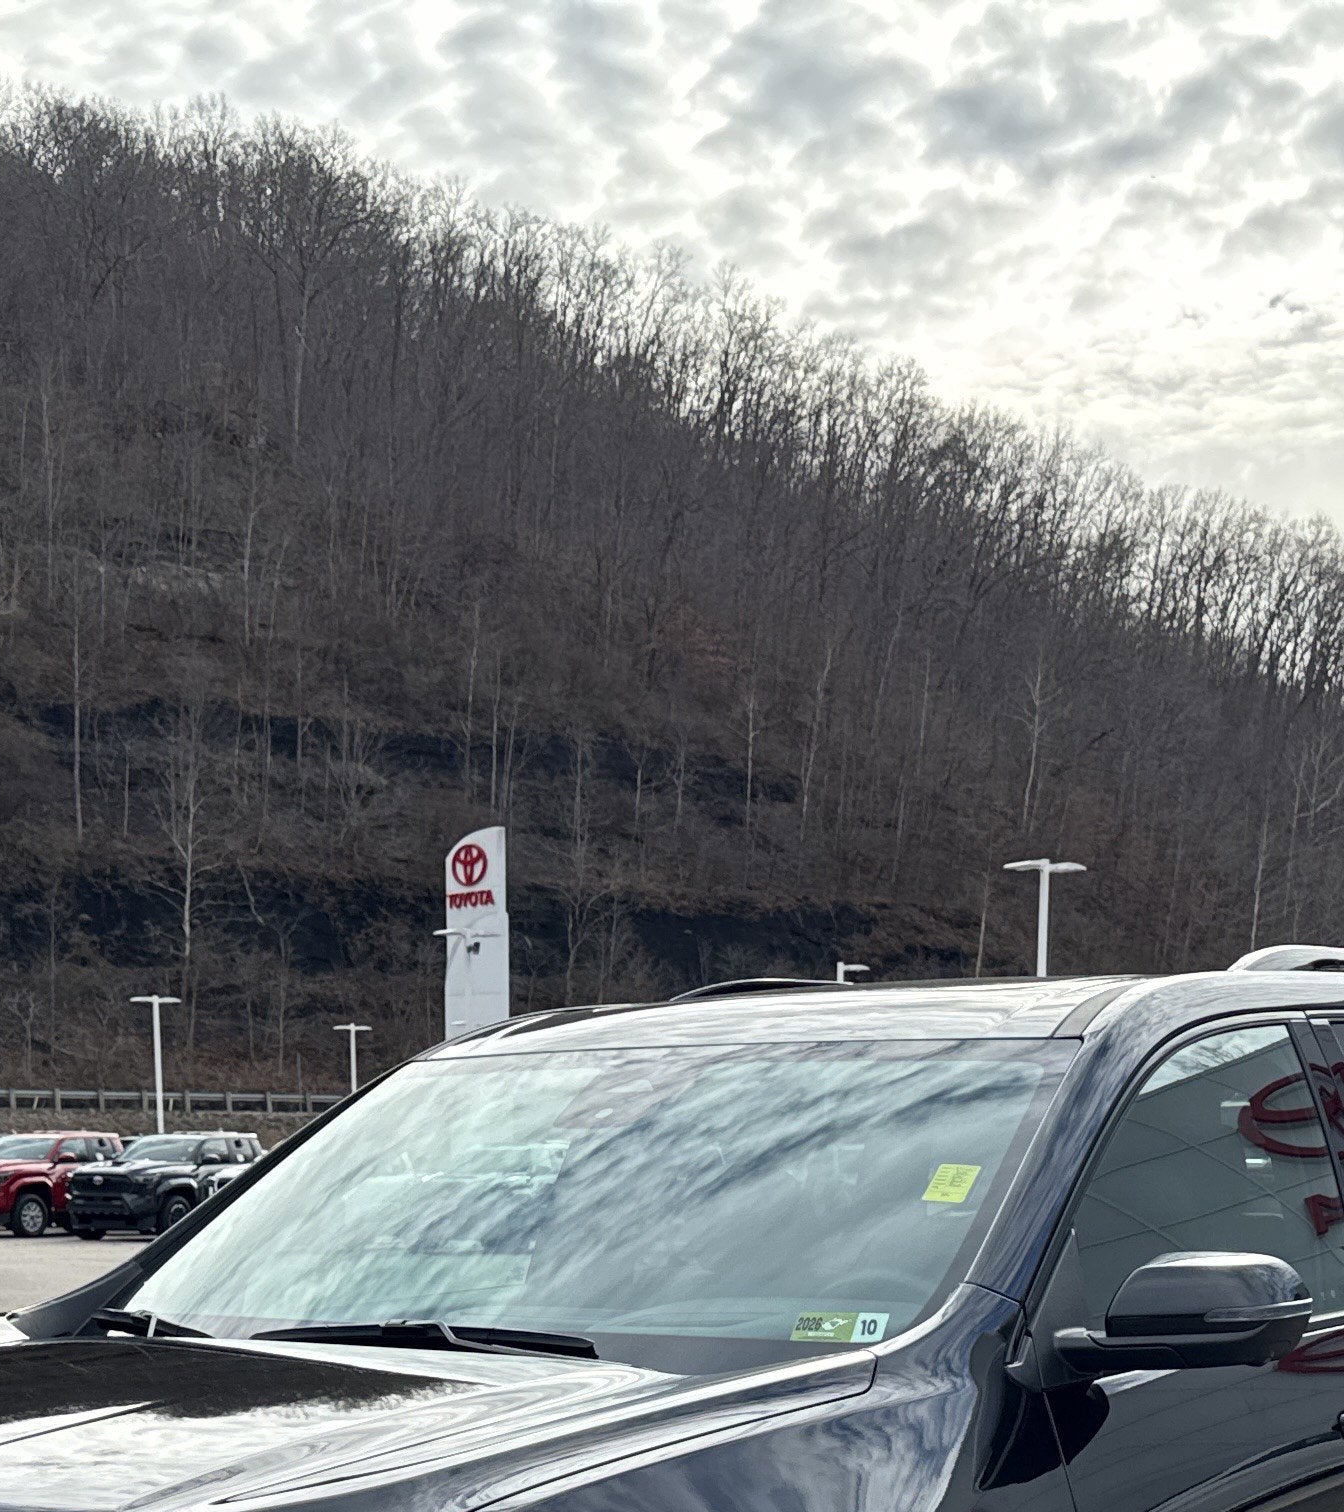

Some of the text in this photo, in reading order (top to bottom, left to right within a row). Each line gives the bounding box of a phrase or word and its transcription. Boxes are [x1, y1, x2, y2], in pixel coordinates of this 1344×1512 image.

[449, 889, 495, 909] TOYOTA
[795, 1316, 878, 1336] 2026 10
